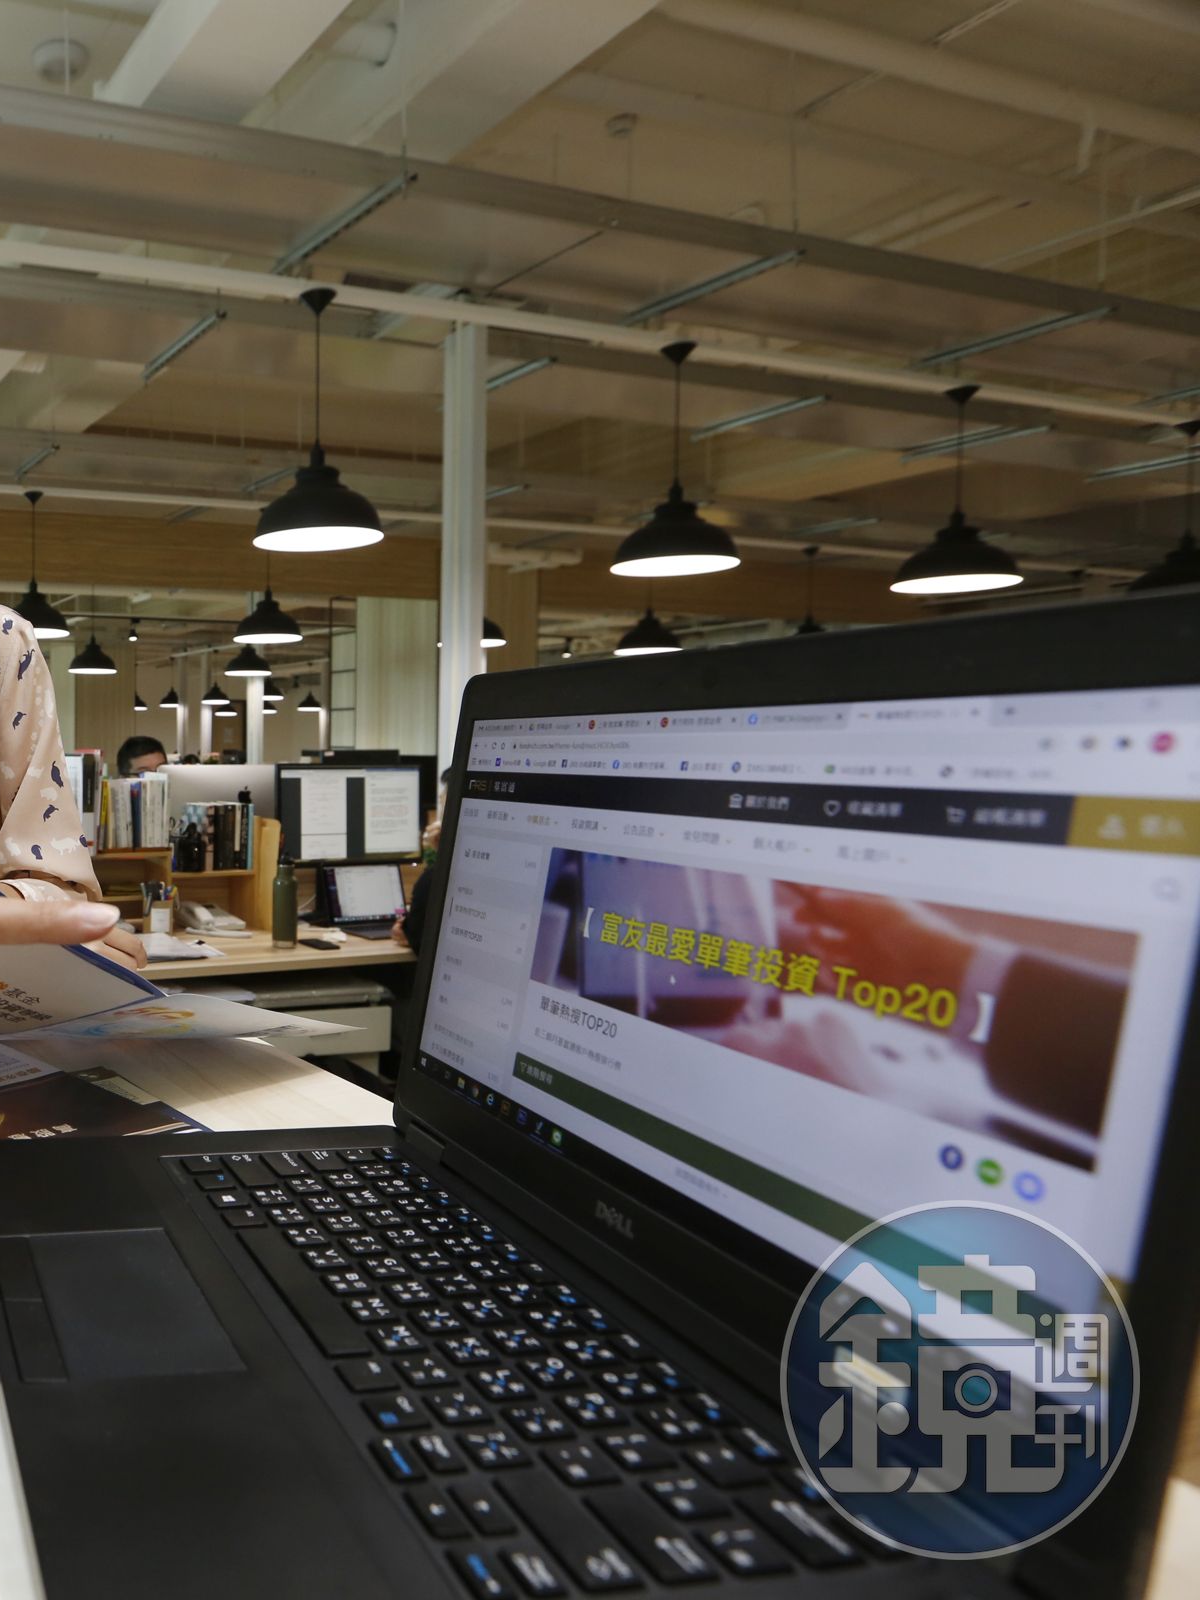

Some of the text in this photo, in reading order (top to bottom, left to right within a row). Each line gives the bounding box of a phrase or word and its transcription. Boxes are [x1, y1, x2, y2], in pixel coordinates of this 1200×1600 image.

[599, 911, 821, 997] 富友最愛單筆投資
[832, 966, 957, 1029] Top20
[595, 1200, 634, 1240] DELL
